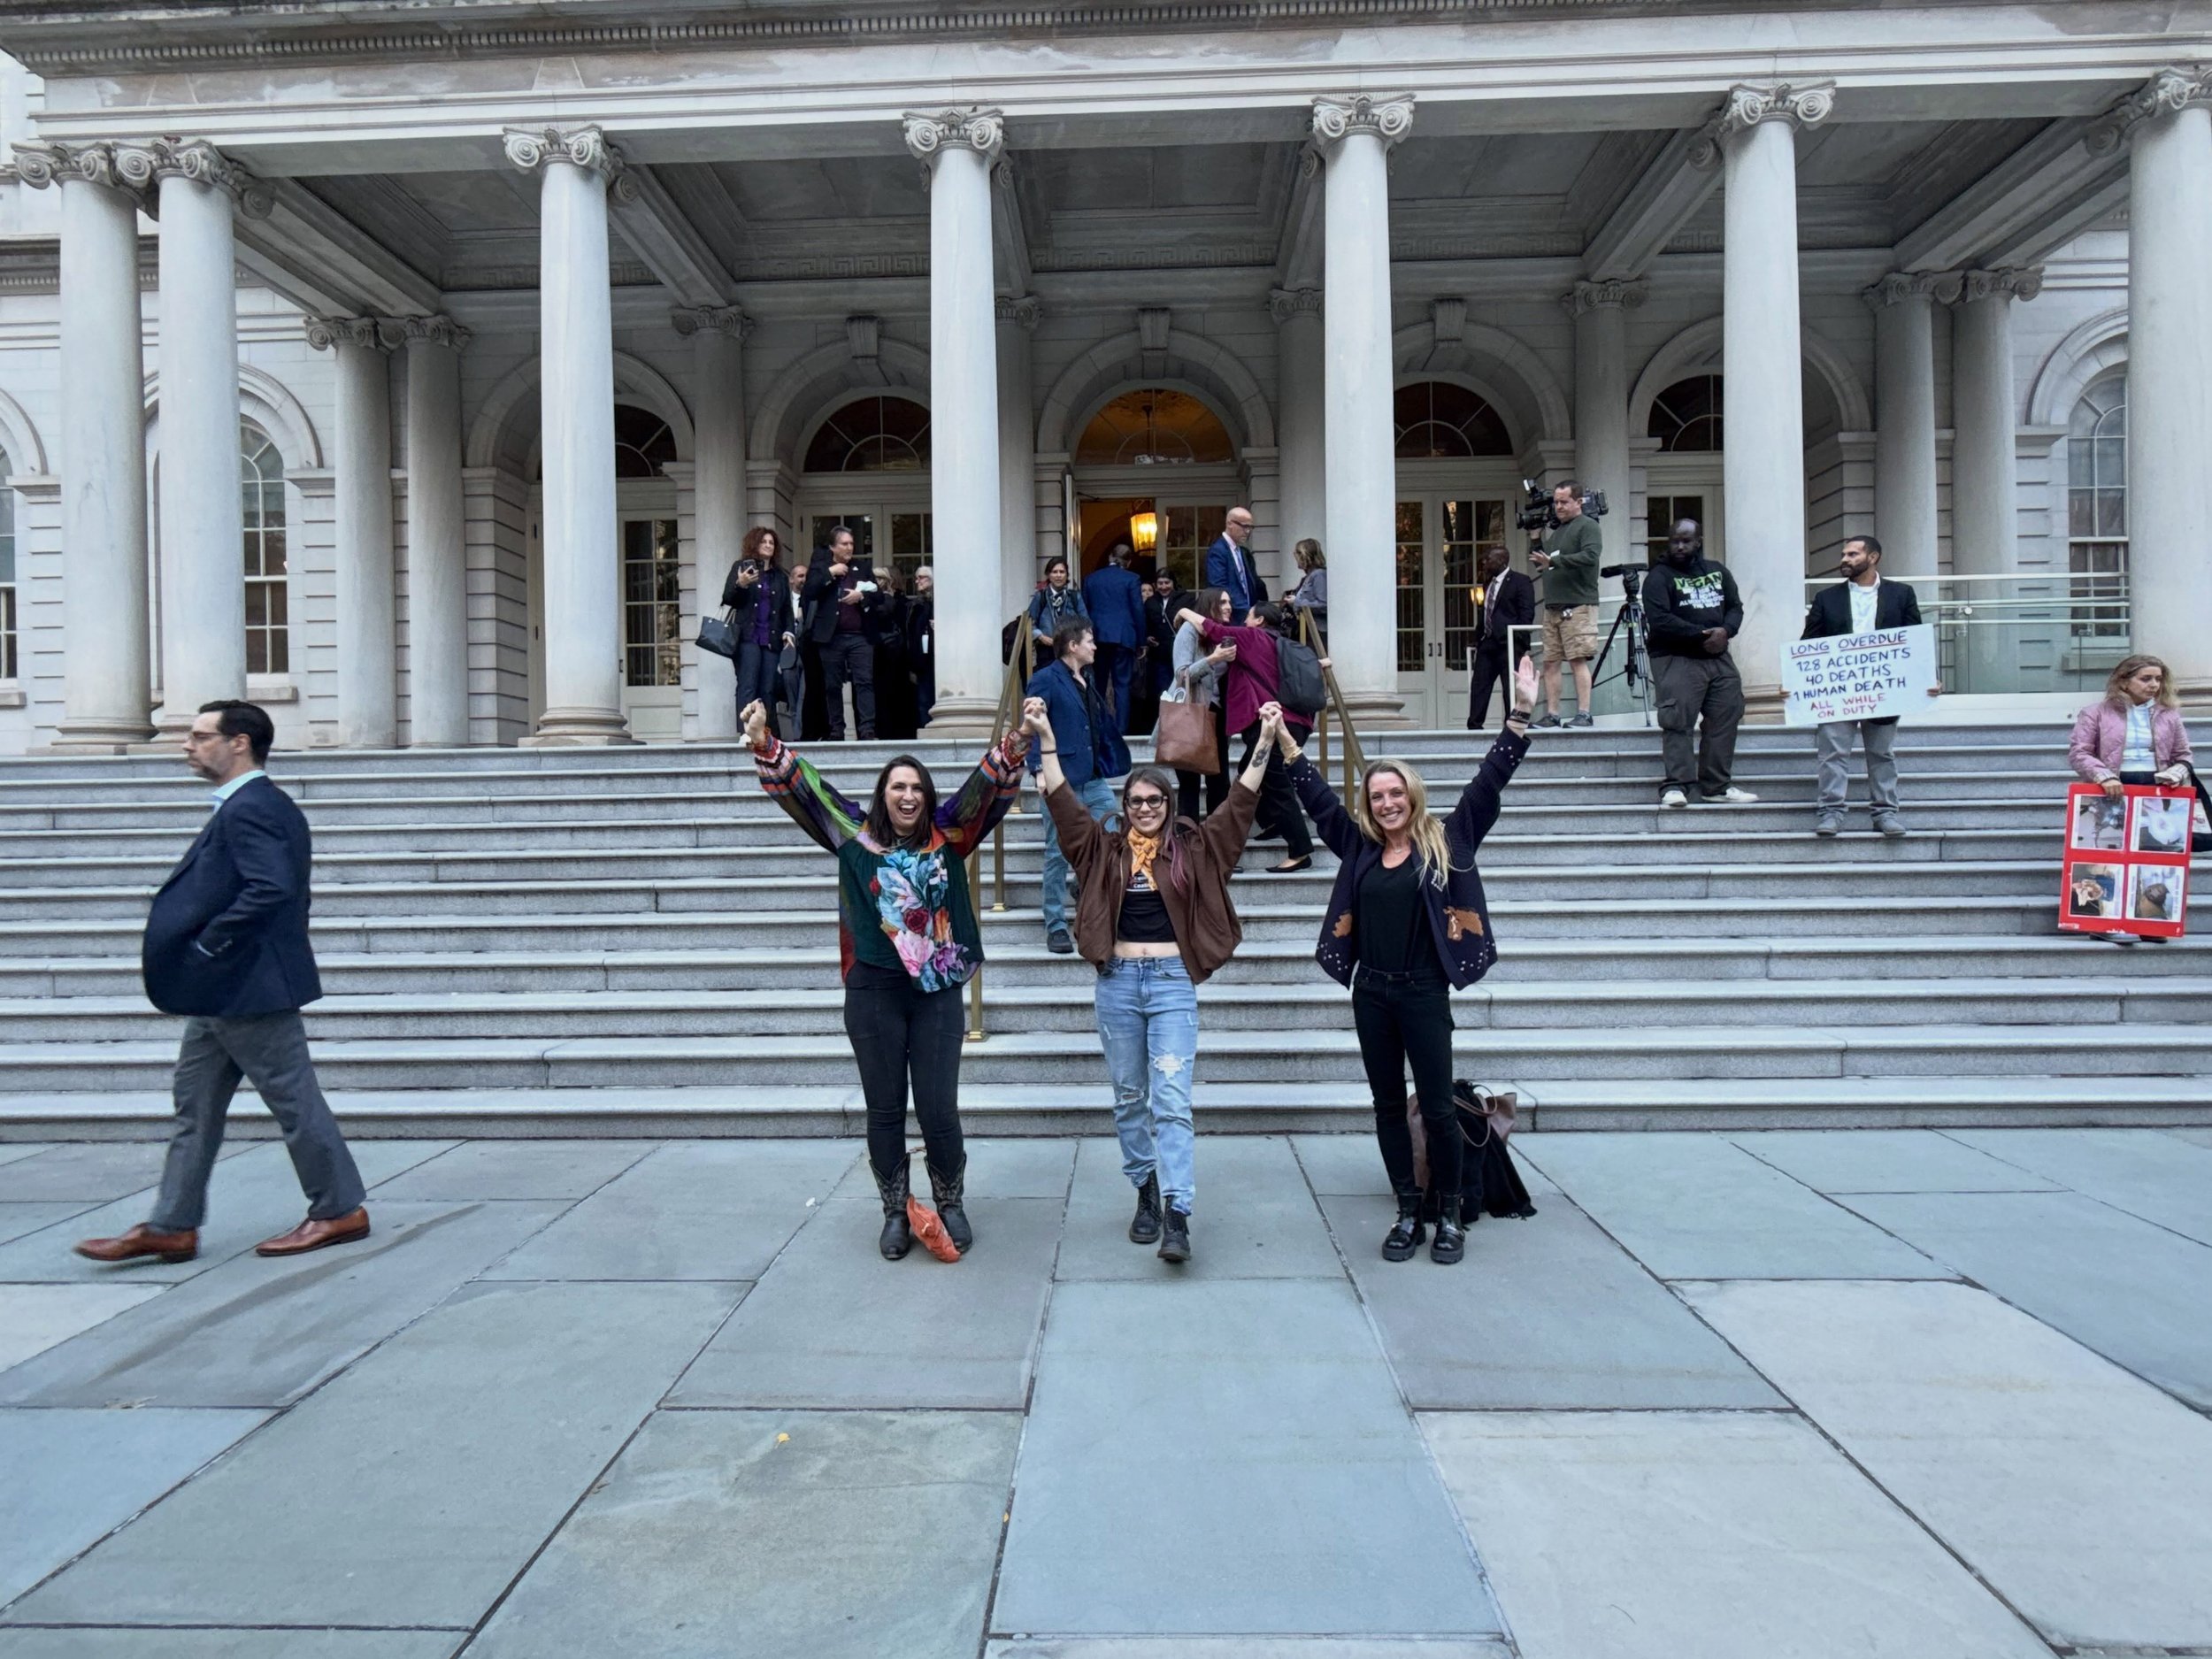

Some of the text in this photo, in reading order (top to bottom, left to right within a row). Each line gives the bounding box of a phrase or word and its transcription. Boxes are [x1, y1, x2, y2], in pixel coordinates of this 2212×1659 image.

[1677, 573, 1722, 588] VEGAN
[1790, 630, 1908, 656] LONG OVERDUE
[1796, 647, 1911, 672] 128 ACCIDENTS
[1806, 664, 1892, 686] 40 DEATHS
[1793, 677, 1907, 702] 1 HUMAN DEATH
[1810, 693, 1886, 710] ALL WHILE
[1817, 703, 1877, 718] ON DUTY
